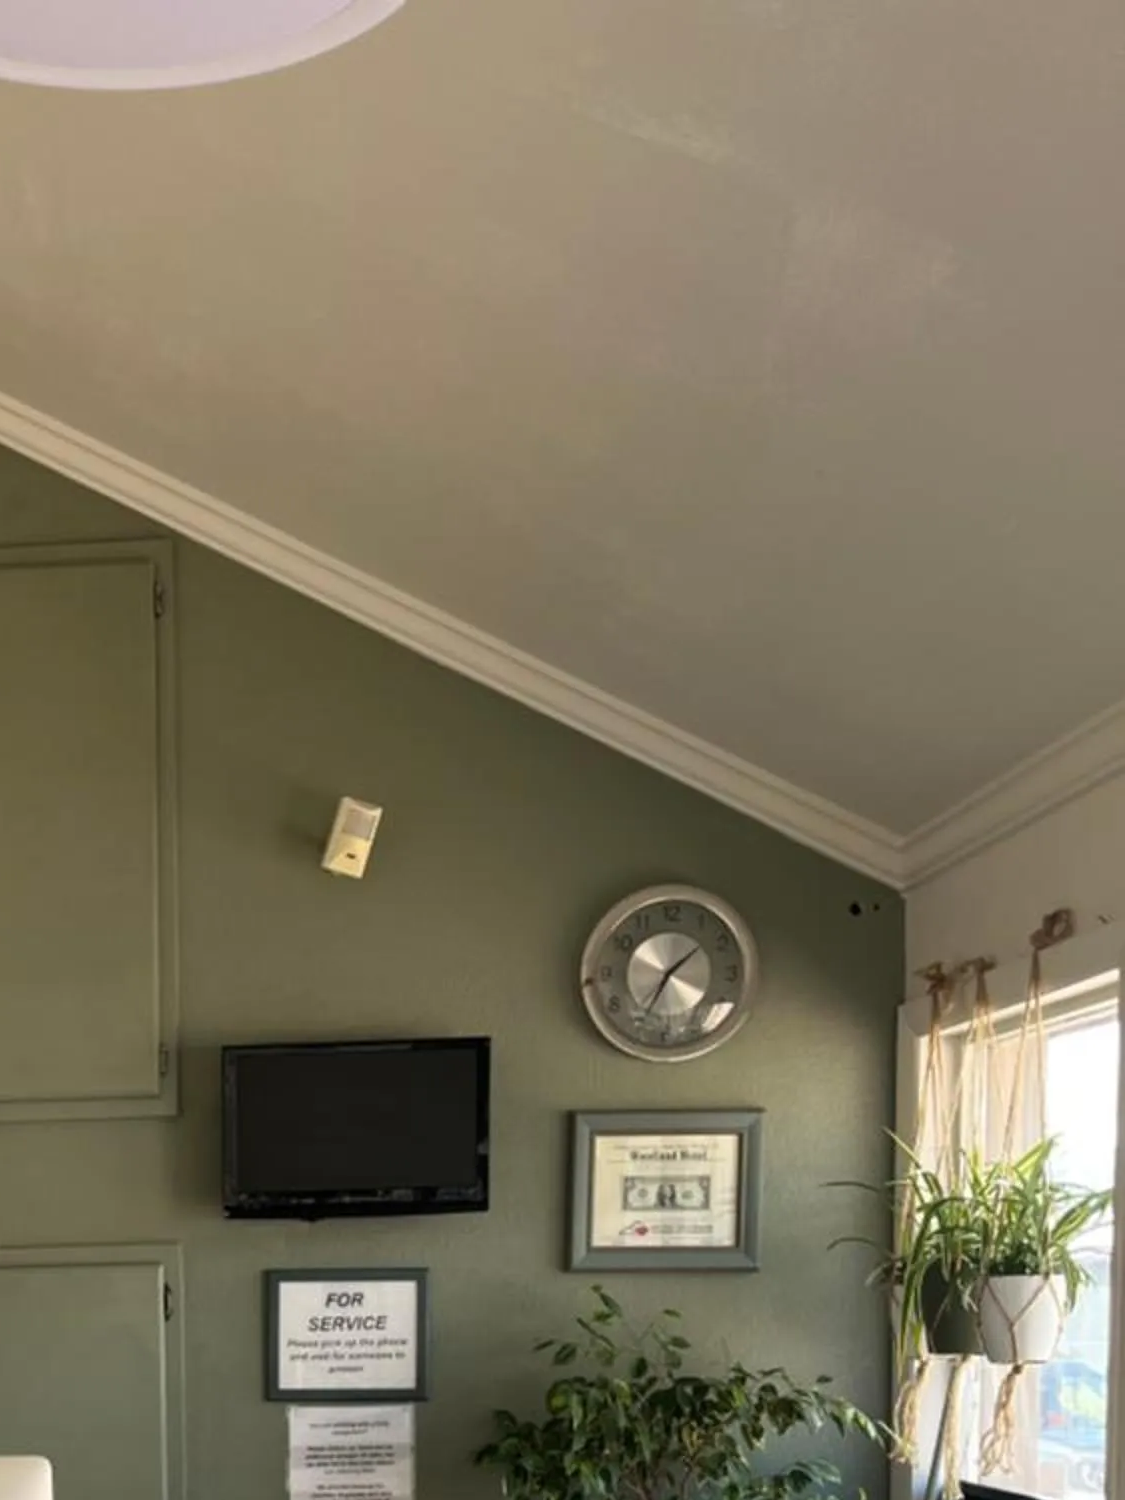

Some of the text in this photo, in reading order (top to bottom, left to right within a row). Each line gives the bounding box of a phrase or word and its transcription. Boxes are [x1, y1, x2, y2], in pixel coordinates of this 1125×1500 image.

[663, 905, 681, 922] 12
[636, 915, 649, 930] 11
[325, 1292, 364, 1308] FOR
[308, 1315, 388, 1332] SERVICE
[287, 1338, 318, 1348] Please
[359, 1338, 374, 1347] the
[377, 1337, 408, 1348] phone
[290, 1352, 309, 1361] and
